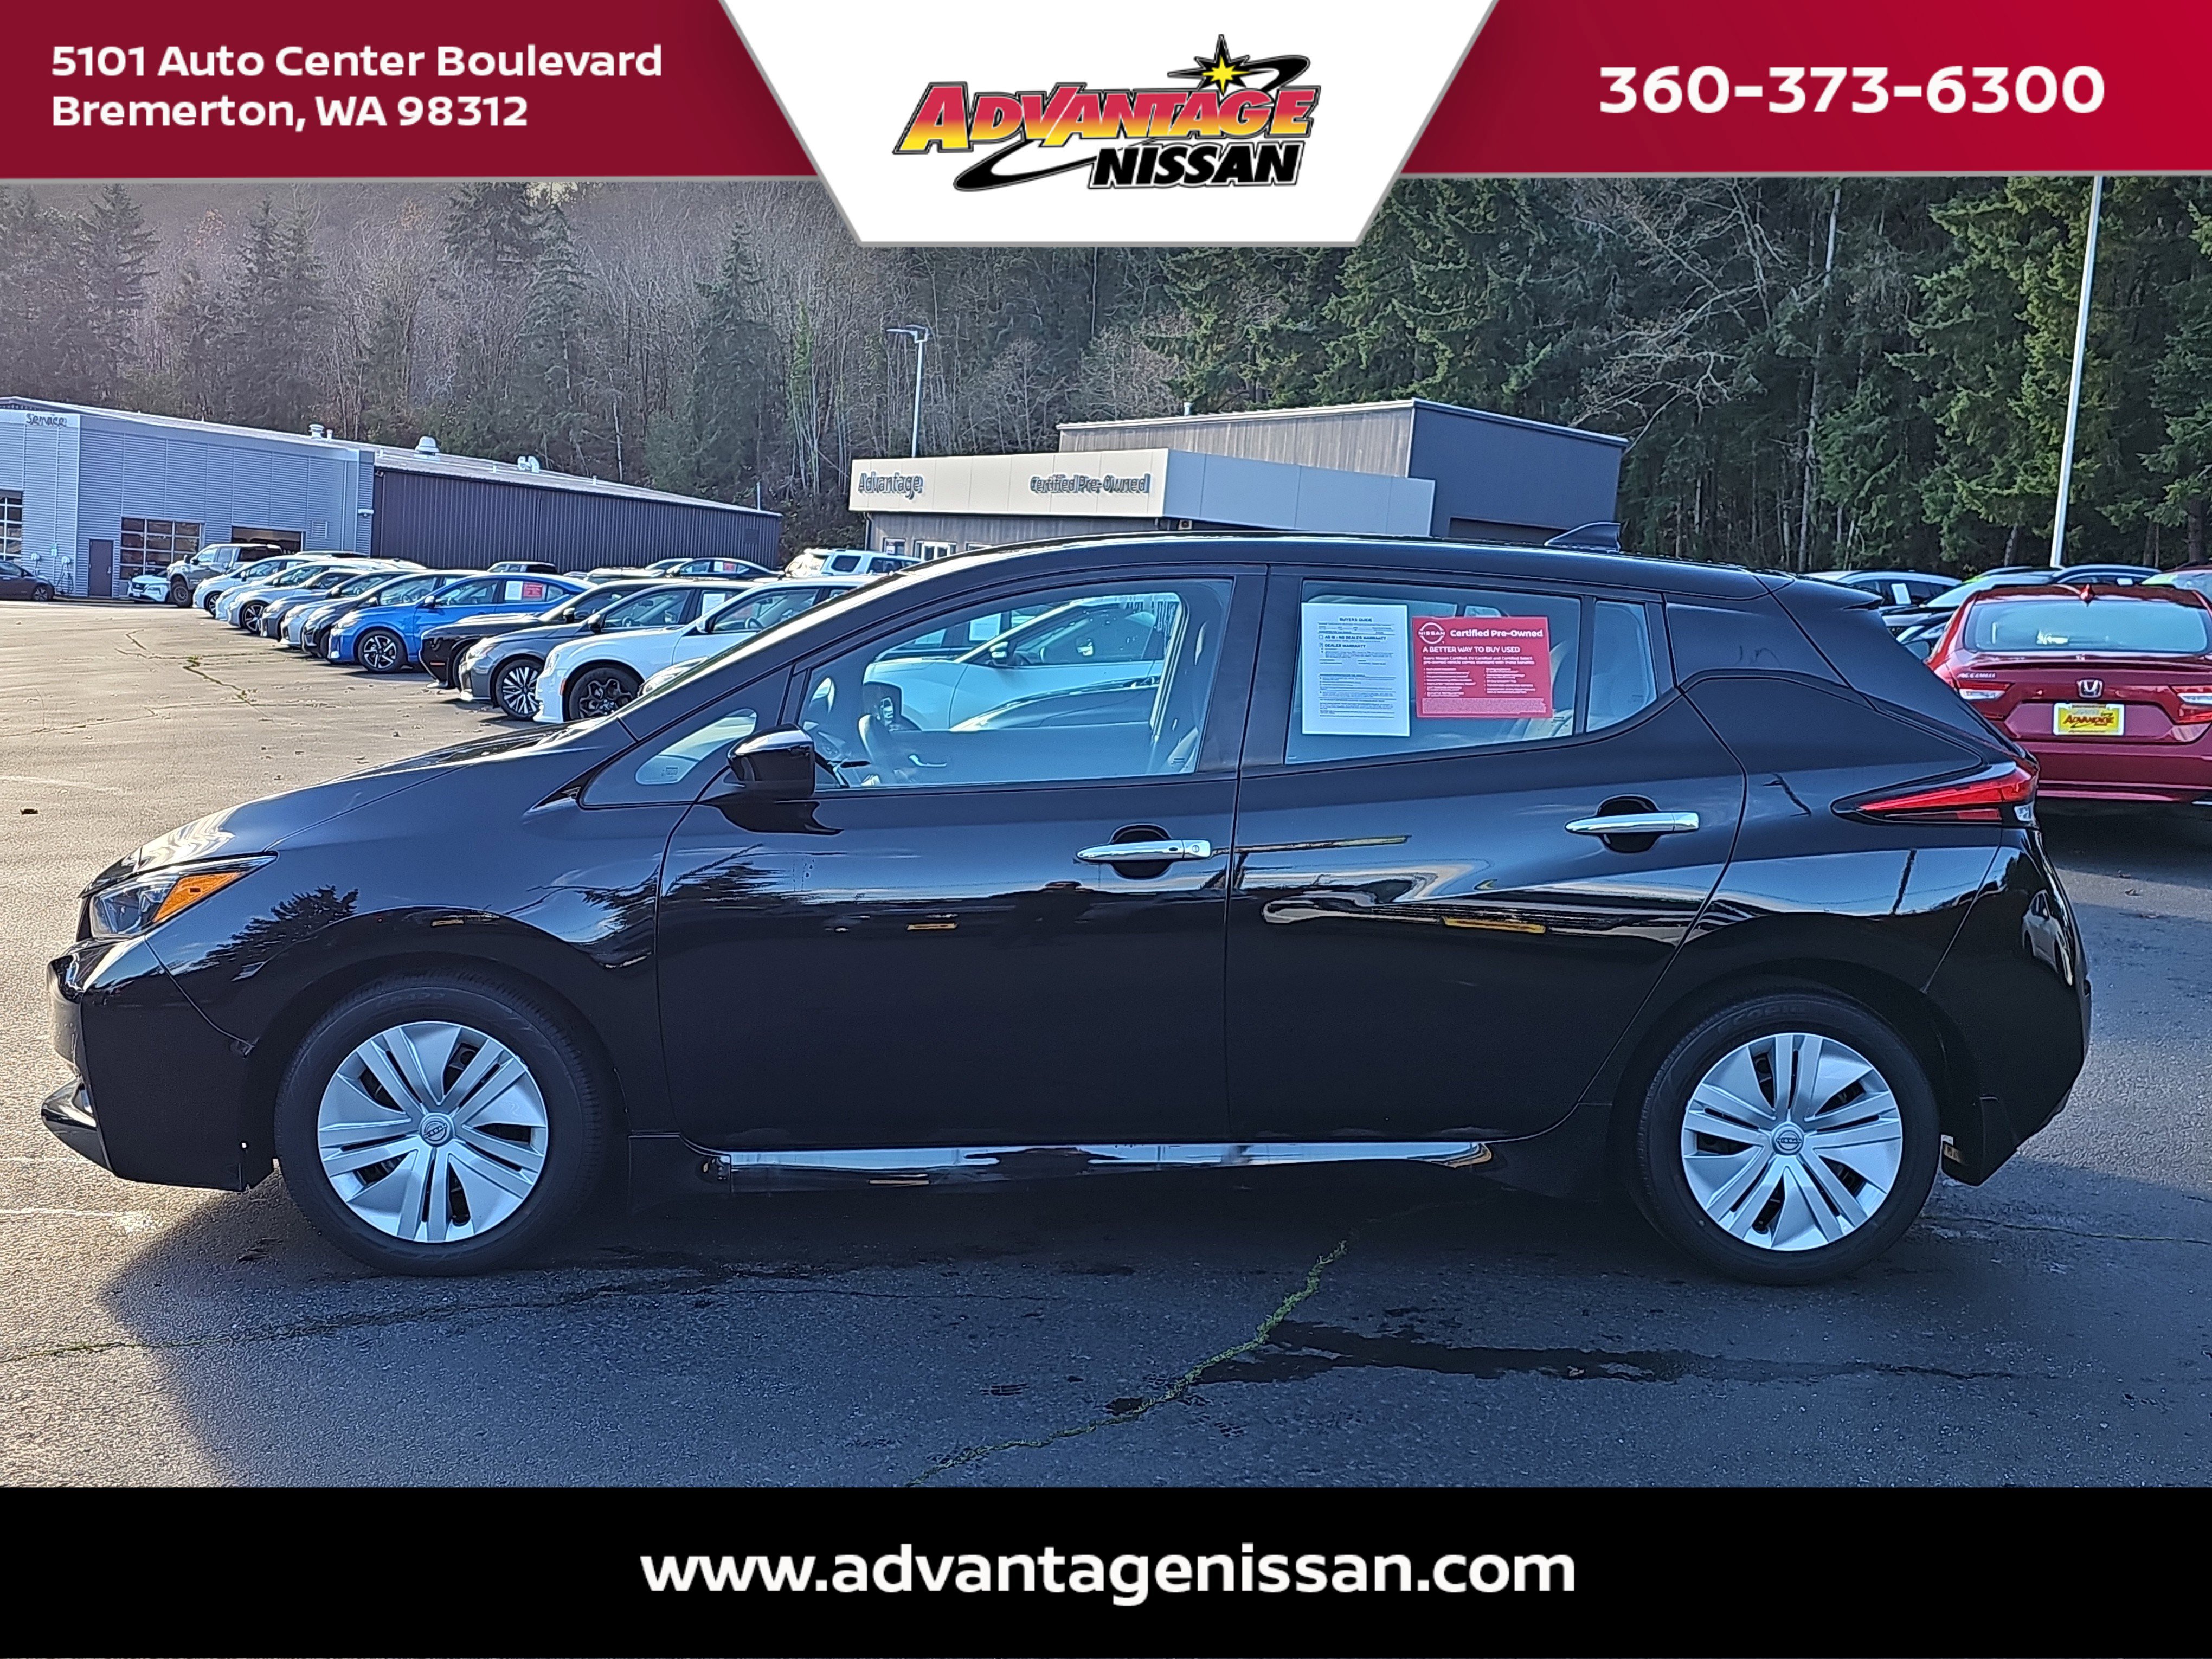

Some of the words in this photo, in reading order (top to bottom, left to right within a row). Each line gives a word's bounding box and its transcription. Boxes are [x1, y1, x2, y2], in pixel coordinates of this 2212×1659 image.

[26, 413, 67, 427] Service
[858, 471, 923, 500] Advantage
[1031, 474, 1078, 493] Certified
[1079, 473, 1151, 493] Pre-Owned
